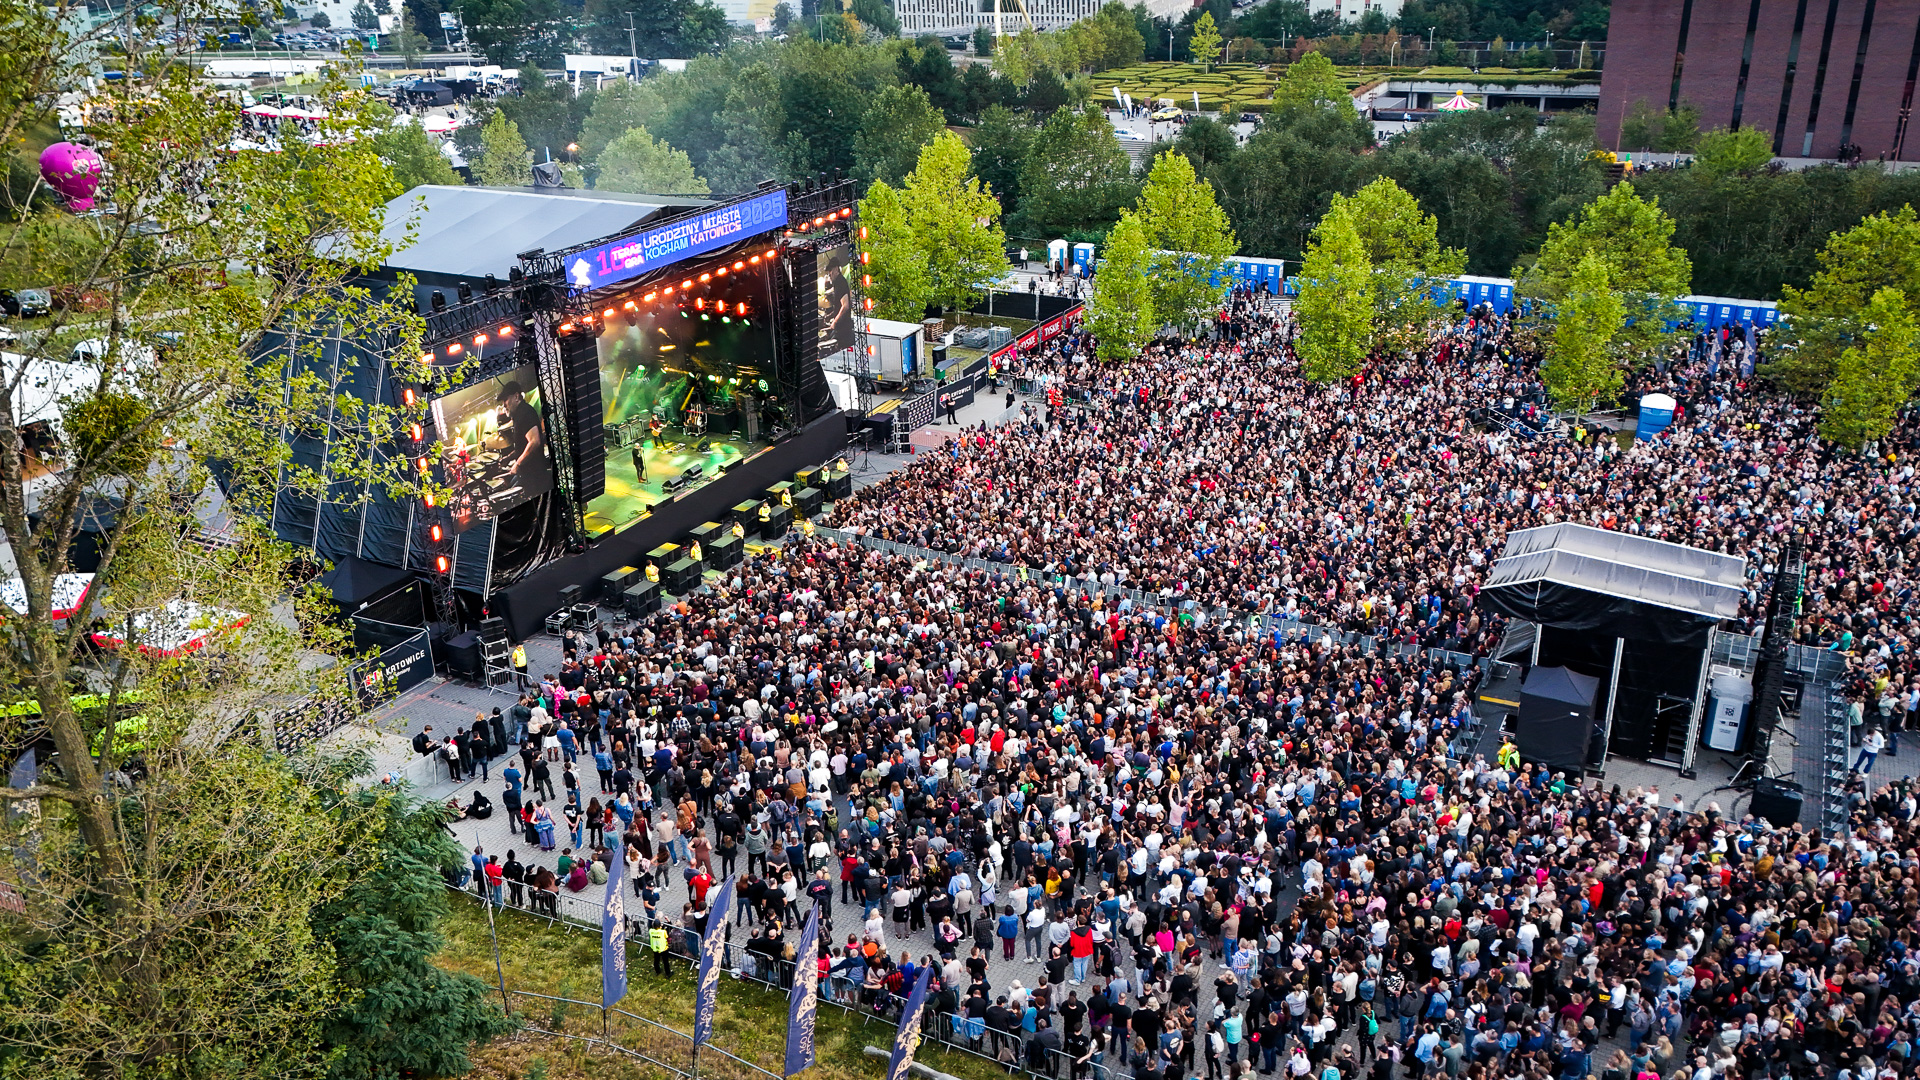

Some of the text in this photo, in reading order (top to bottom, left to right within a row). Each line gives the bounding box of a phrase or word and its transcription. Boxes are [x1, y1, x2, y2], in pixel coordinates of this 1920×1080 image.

[643, 209, 741, 248] URODZINY MIASTA
[741, 195, 783, 229] 2025
[611, 243, 643, 260] TERAZ
[645, 220, 742, 261] KOCHAM KATOWICE
[385, 649, 425, 675] KATOWICE
[799, 1017, 809, 1054] 160 LAT
